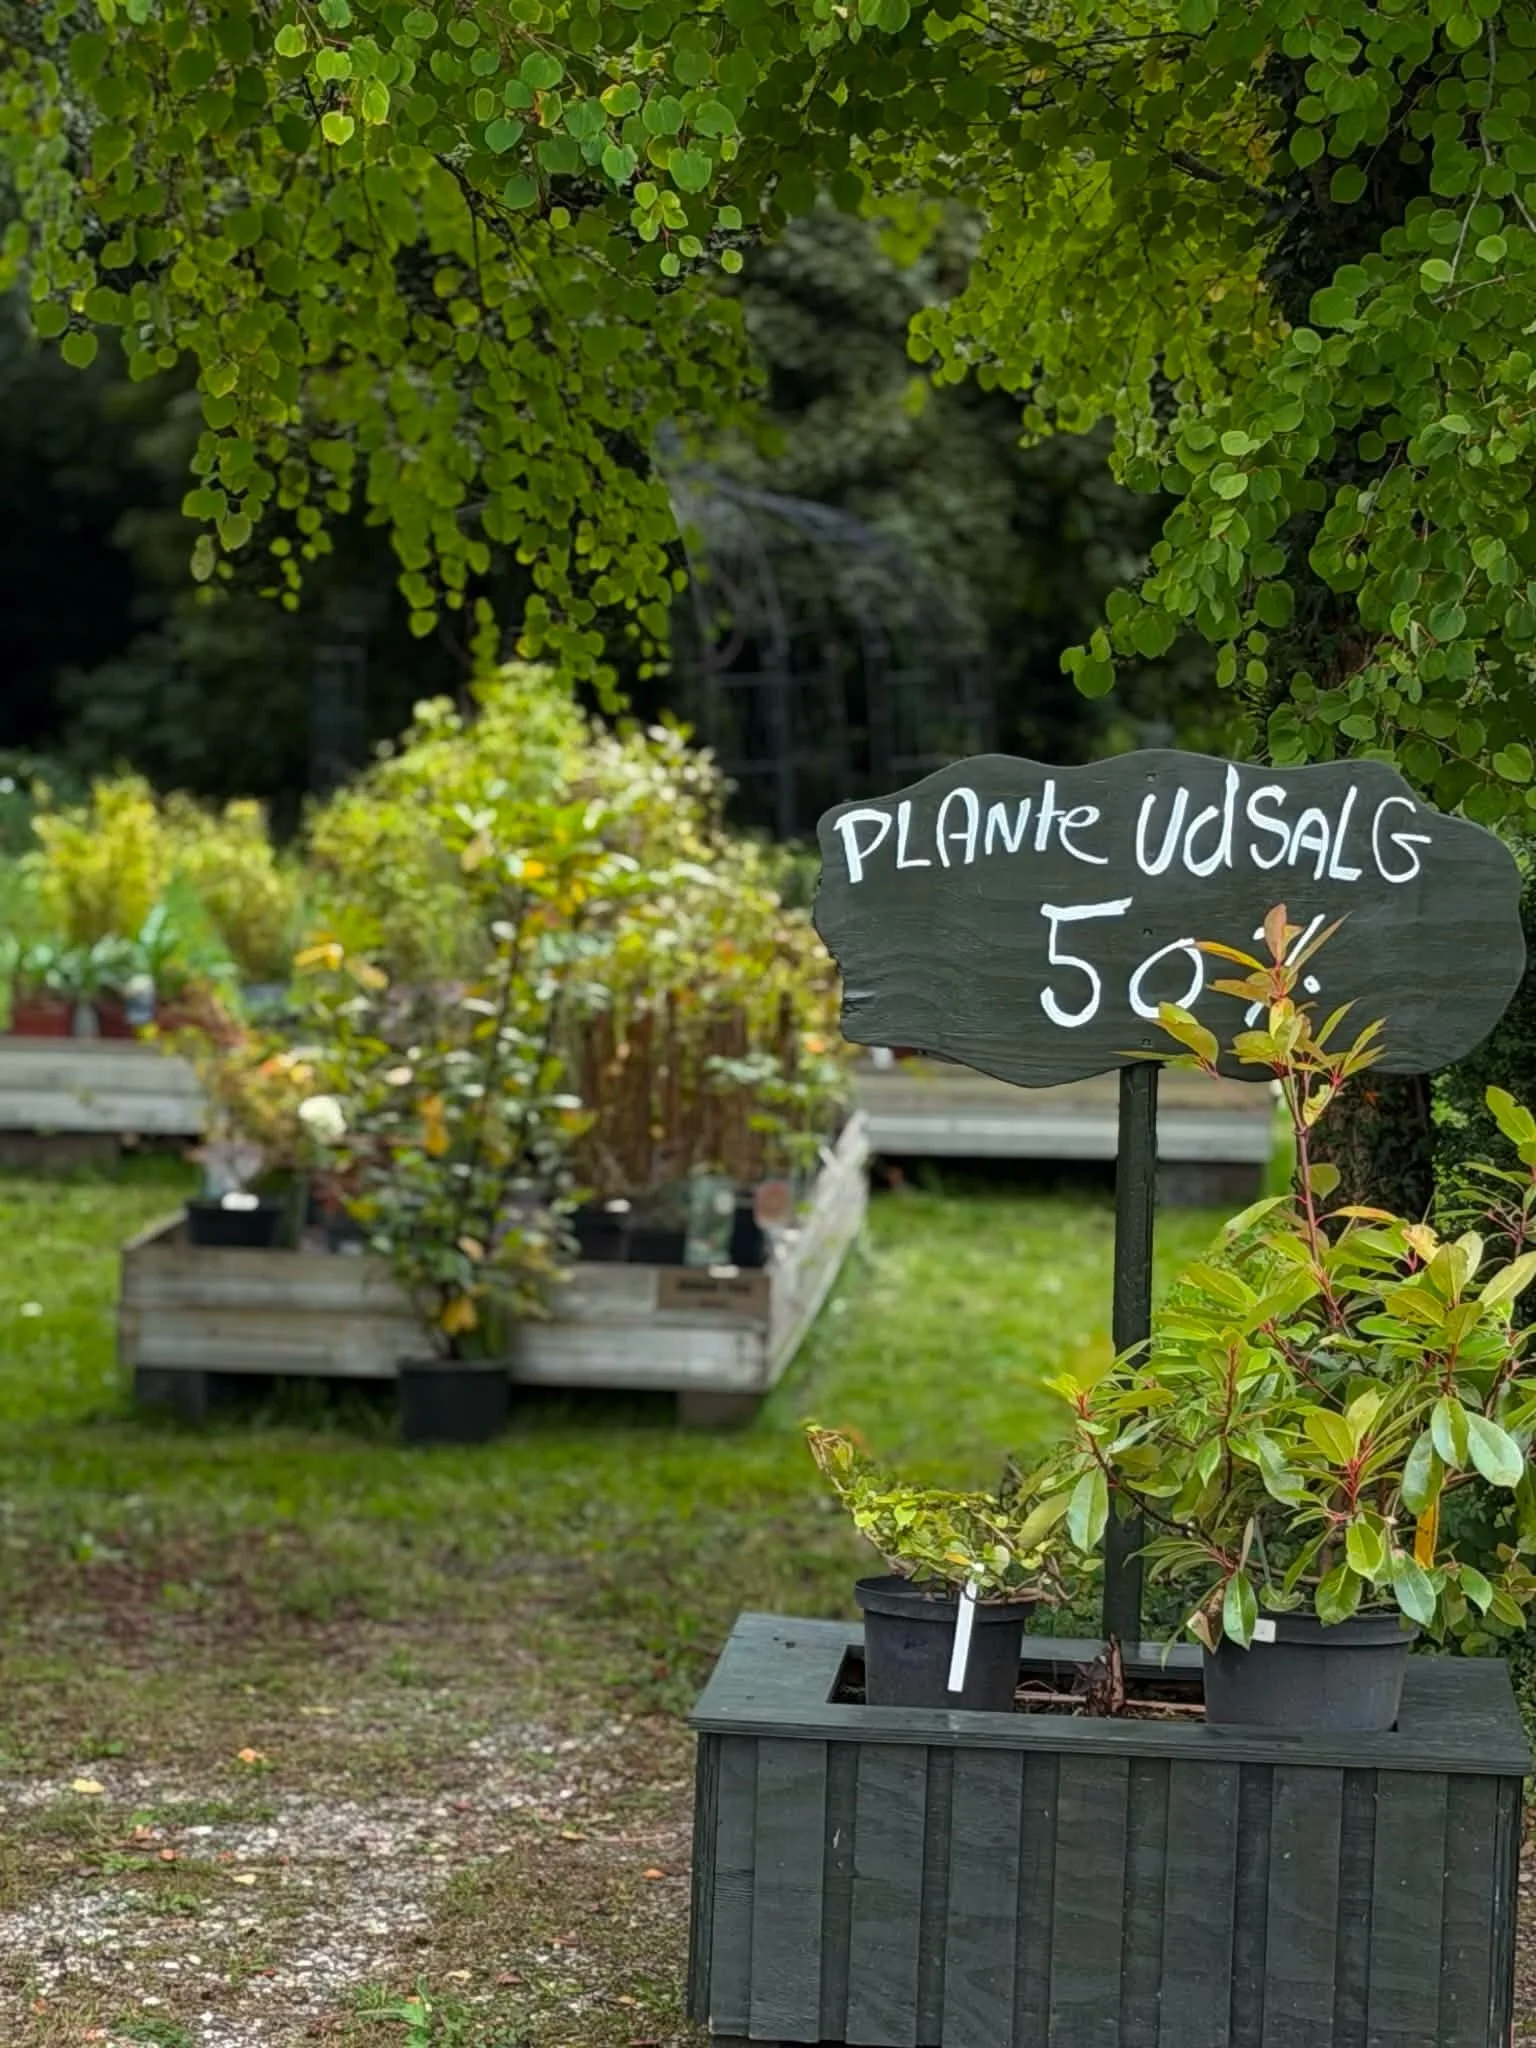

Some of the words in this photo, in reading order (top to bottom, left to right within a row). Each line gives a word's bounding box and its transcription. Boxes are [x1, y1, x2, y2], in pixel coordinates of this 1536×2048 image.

[833, 780, 1109, 883] PLANte
[1136, 764, 1432, 883] UdSALG
[1040, 896, 1204, 1027] 50
